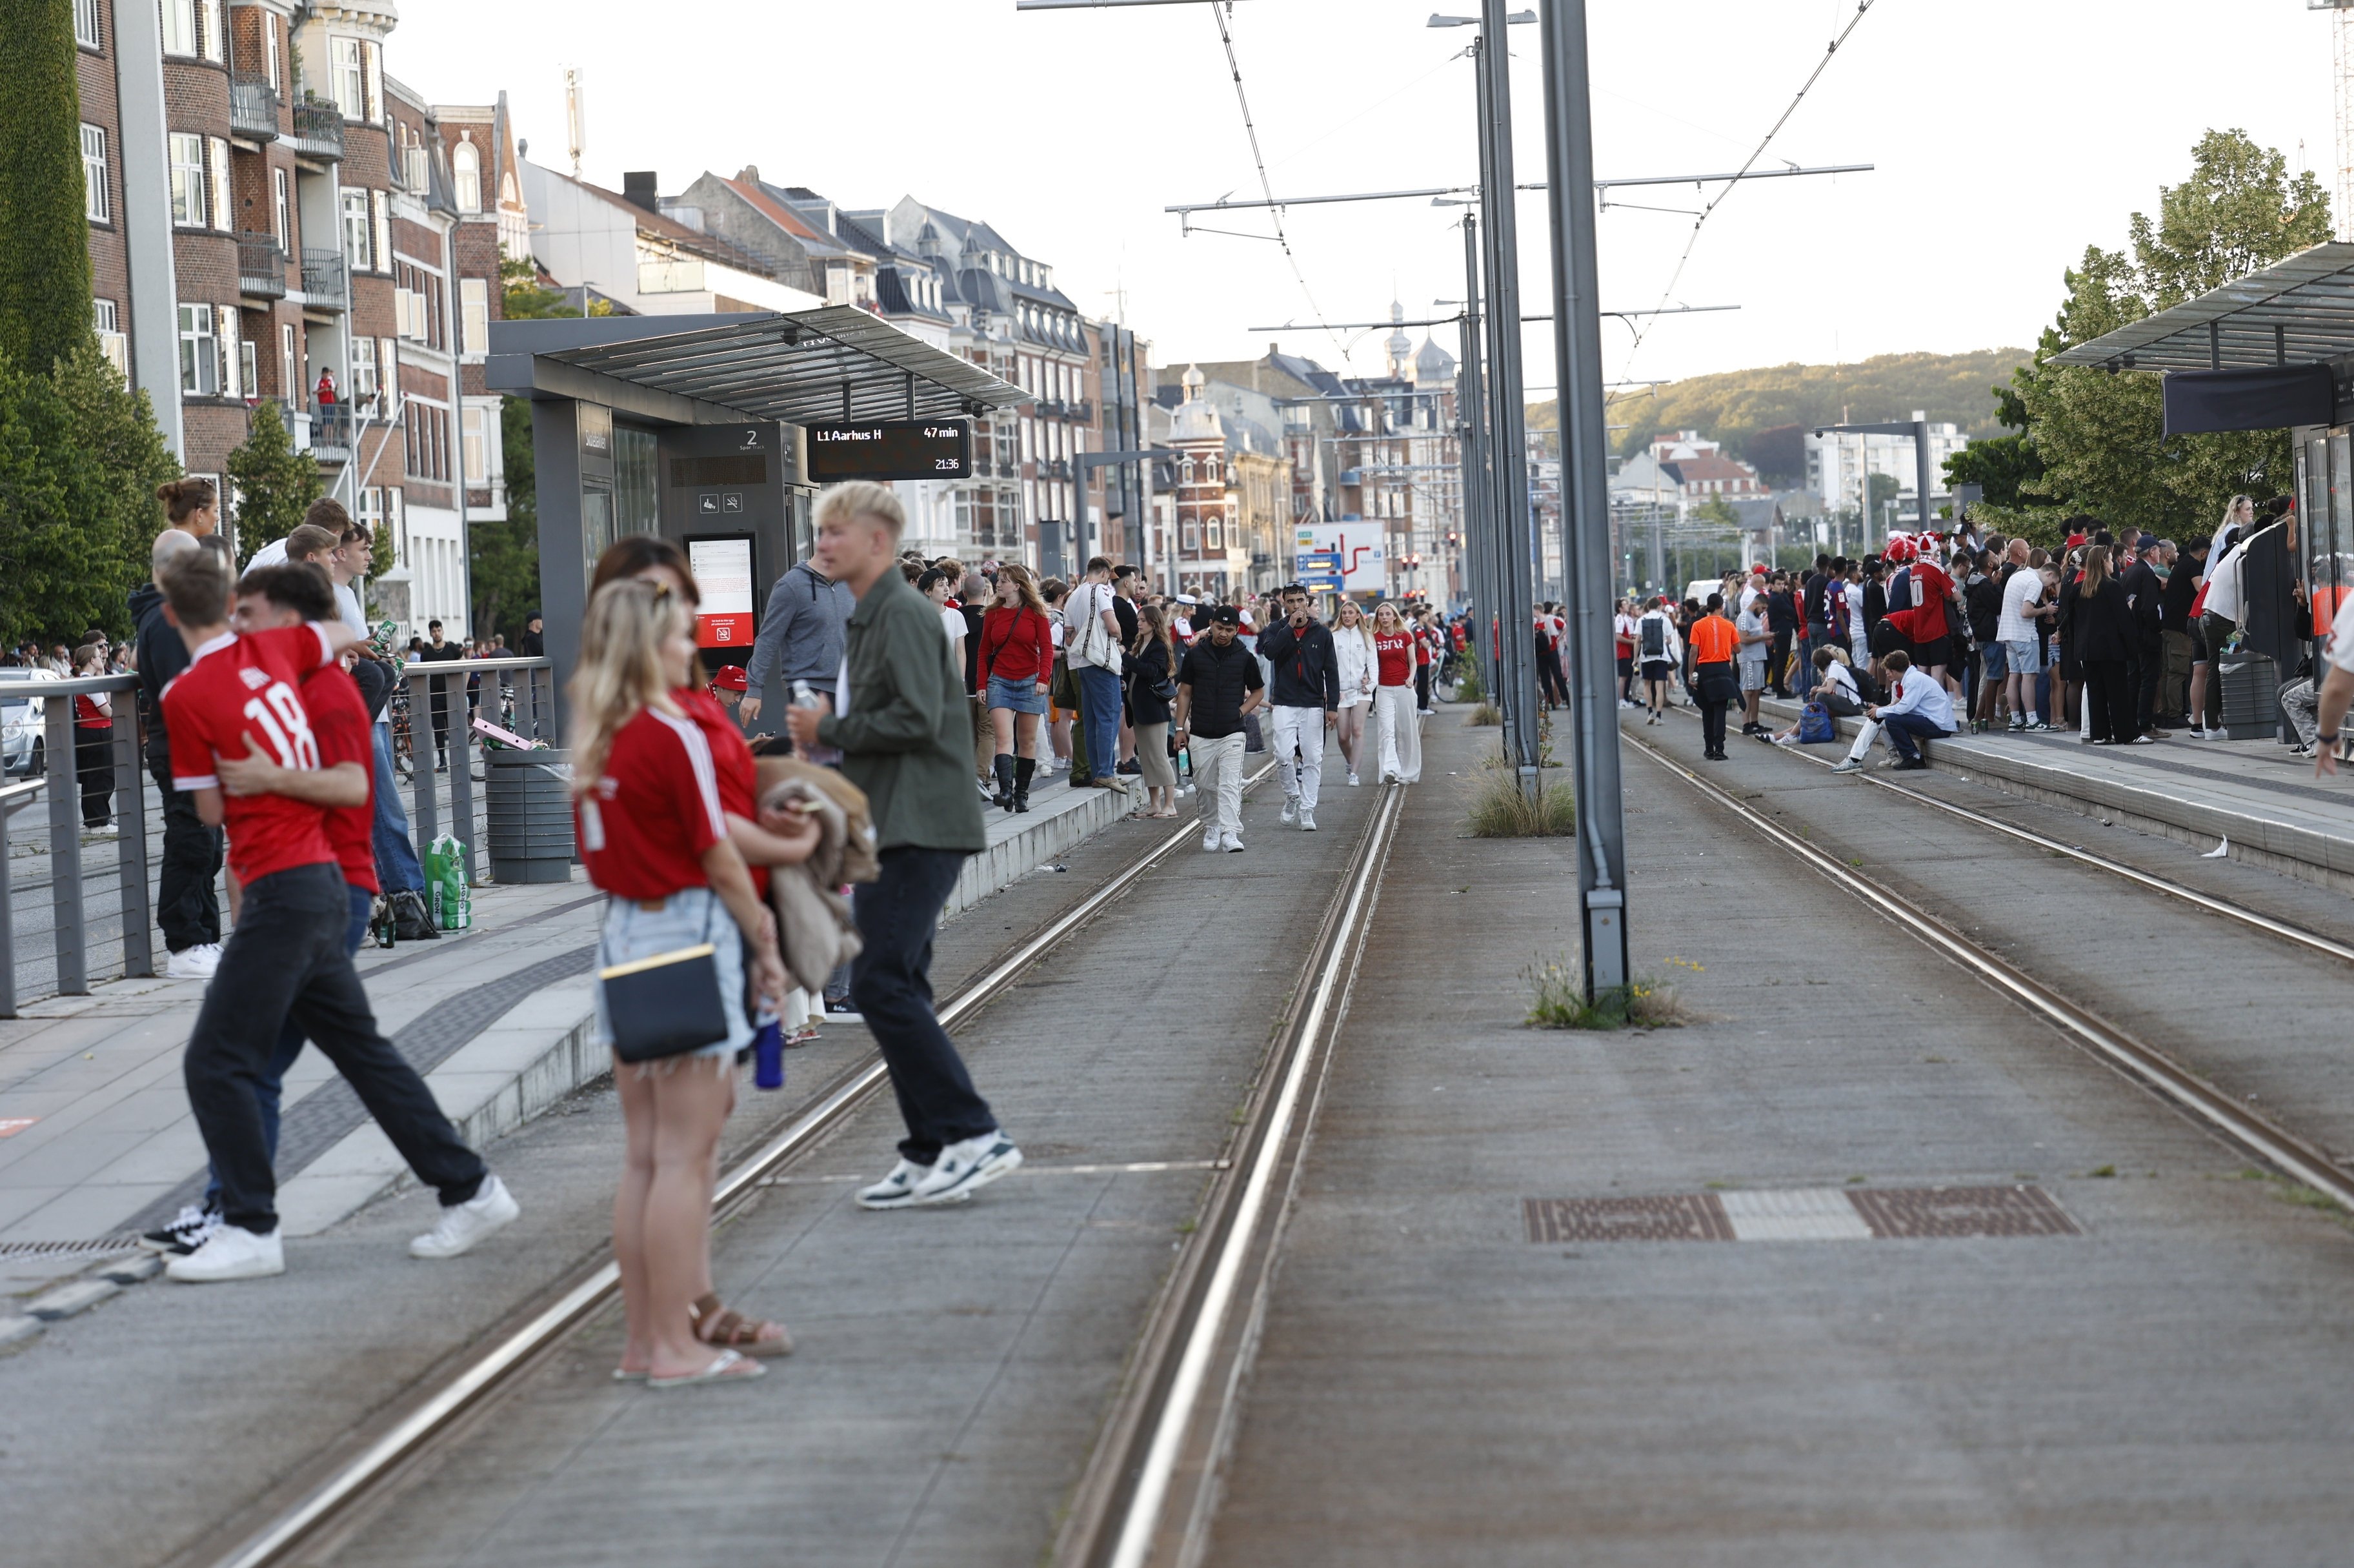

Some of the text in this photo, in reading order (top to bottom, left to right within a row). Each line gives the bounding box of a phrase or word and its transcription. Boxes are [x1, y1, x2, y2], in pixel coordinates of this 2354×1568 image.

[747, 430, 757, 445] 2
[817, 427, 958, 441] L1 Aarhus H 47 min
[935, 458, 959, 470] 21:36
[243, 681, 321, 772] 18
